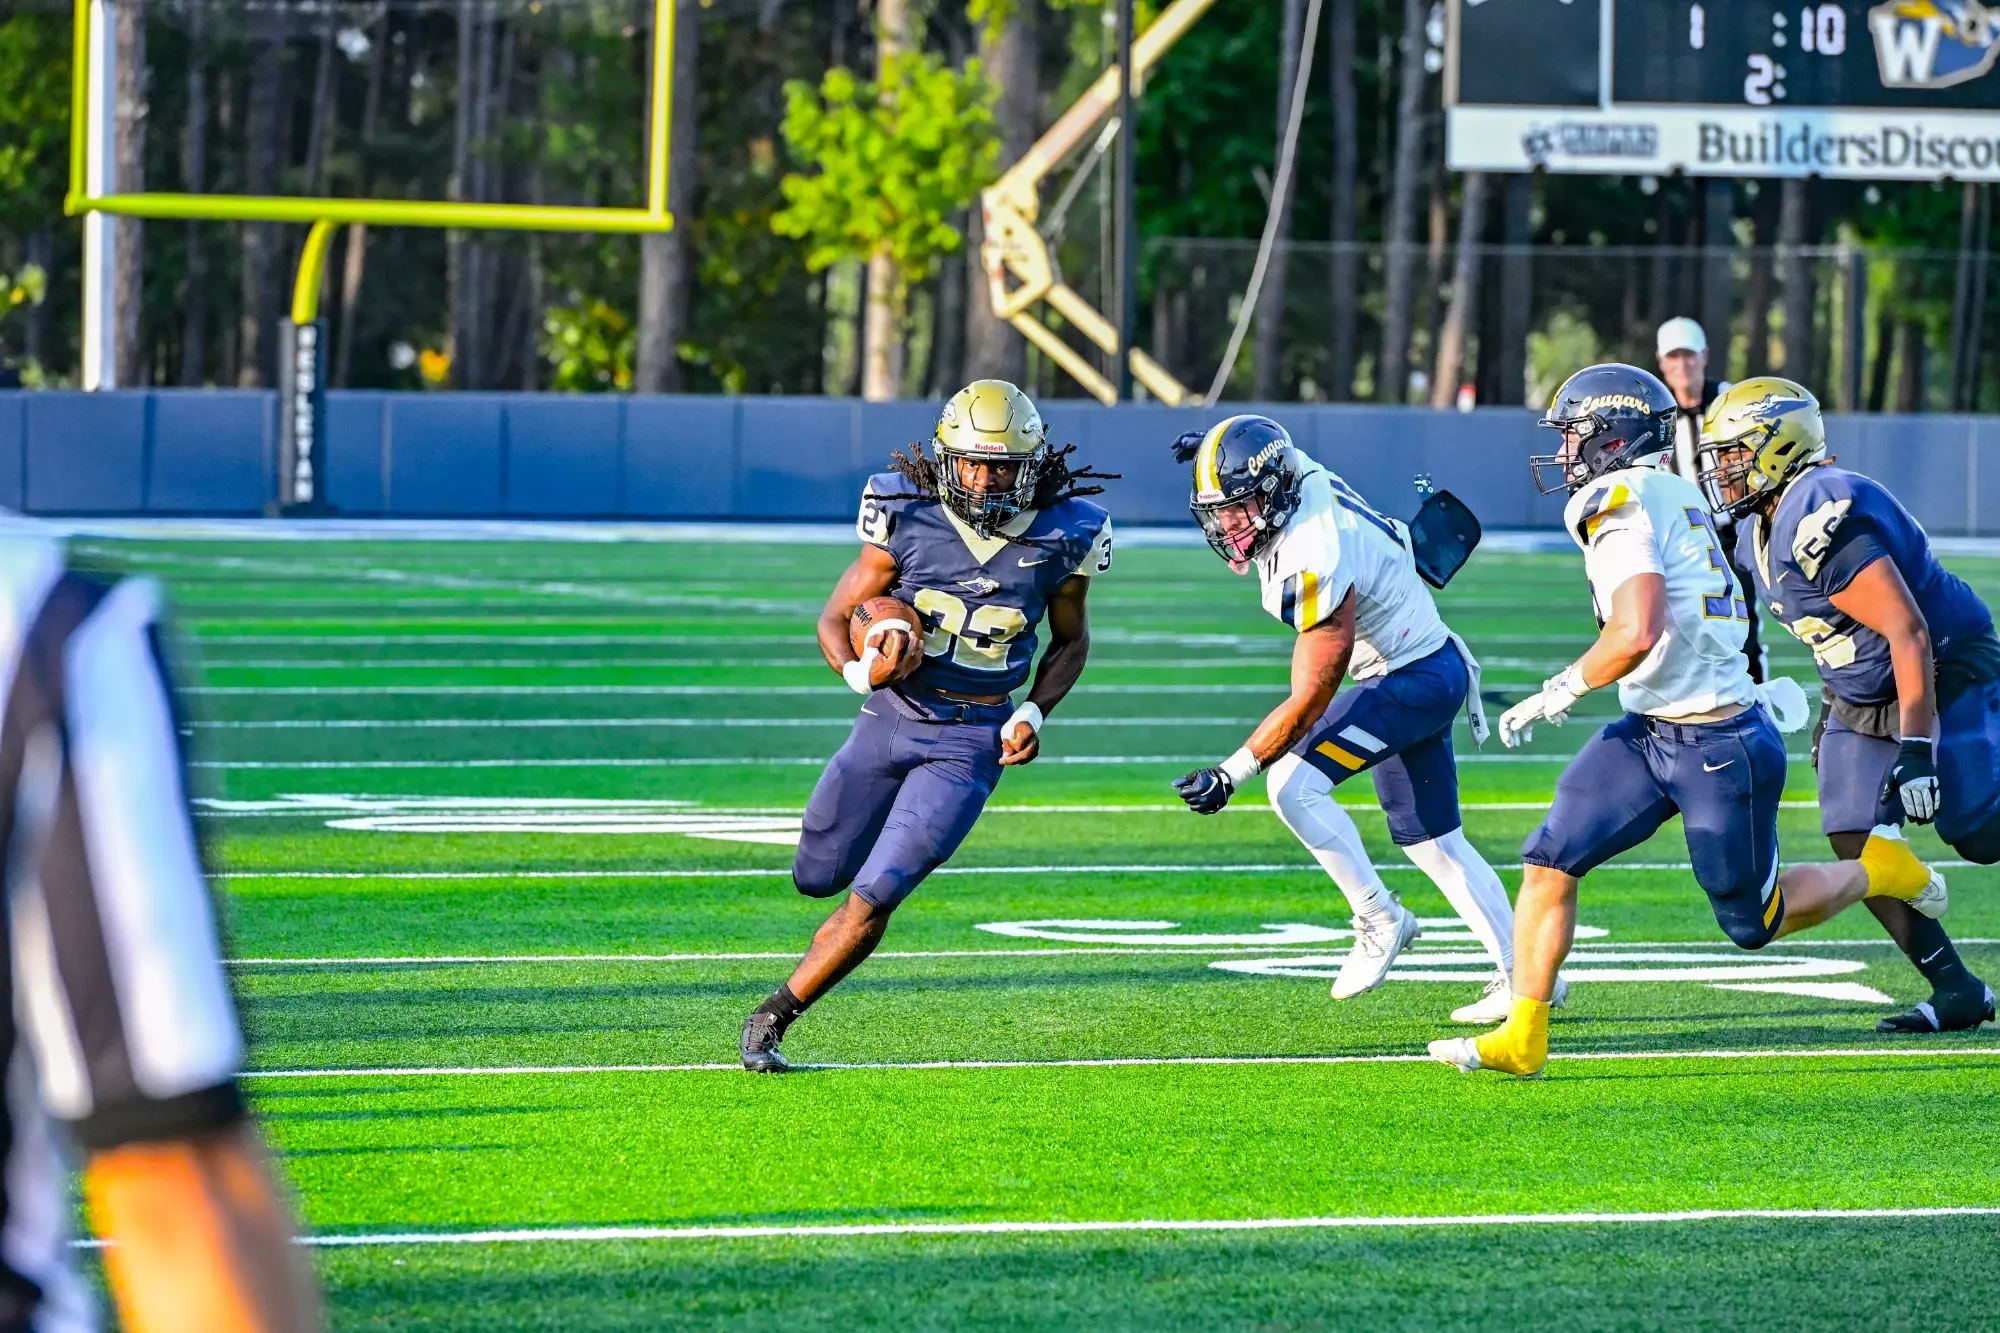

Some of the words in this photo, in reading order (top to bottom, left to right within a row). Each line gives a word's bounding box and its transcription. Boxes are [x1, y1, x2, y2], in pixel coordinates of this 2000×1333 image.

[1689, 4, 1705, 49] 1
[1873, 12, 1942, 84] W
[1698, 122, 2000, 170] BuildersDisco
[1576, 394, 1651, 417] Cougars
[974, 443, 1004, 451] Riddell
[1248, 438, 1292, 477] Cougars
